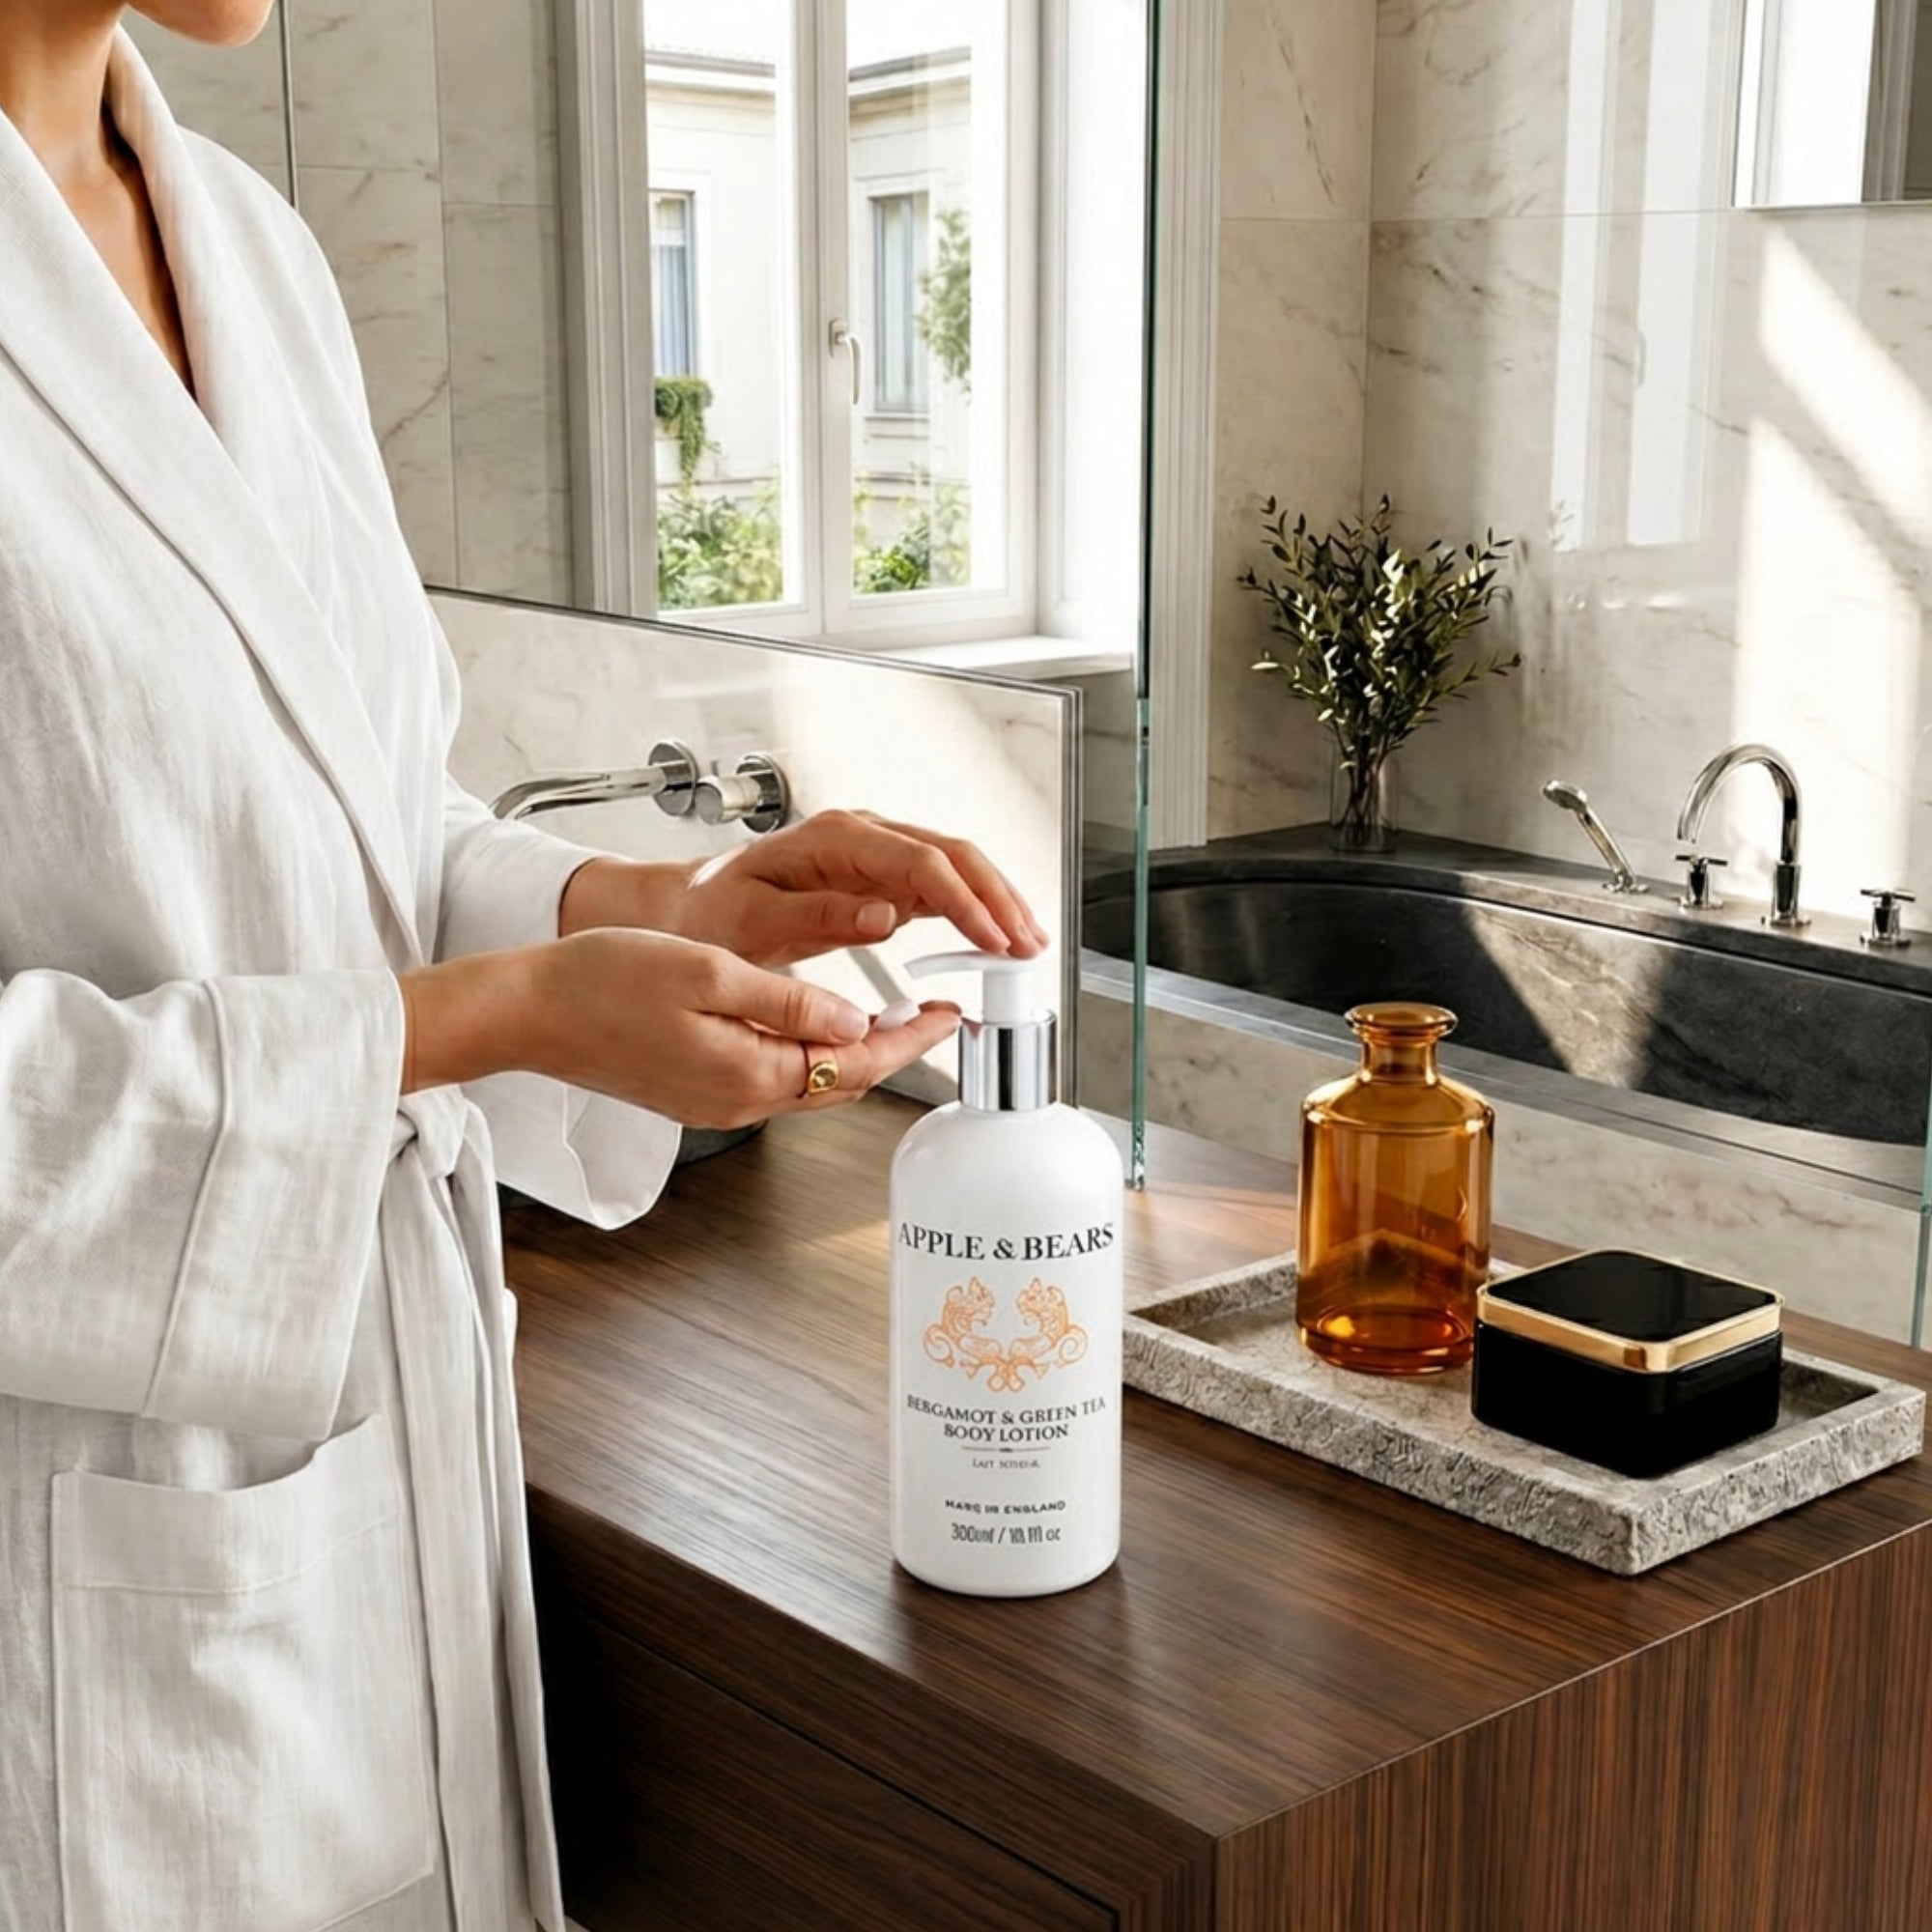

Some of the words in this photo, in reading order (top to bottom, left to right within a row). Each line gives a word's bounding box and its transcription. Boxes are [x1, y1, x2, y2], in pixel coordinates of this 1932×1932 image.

[898, 1221, 985, 1261] APPLE
[993, 1237, 1015, 1260] &
[1020, 1221, 1115, 1261] BEARS
[1001, 1410, 1015, 1425] &
[1081, 1397, 1106, 1415] TEA
[999, 1423, 1069, 1442] LOTION
